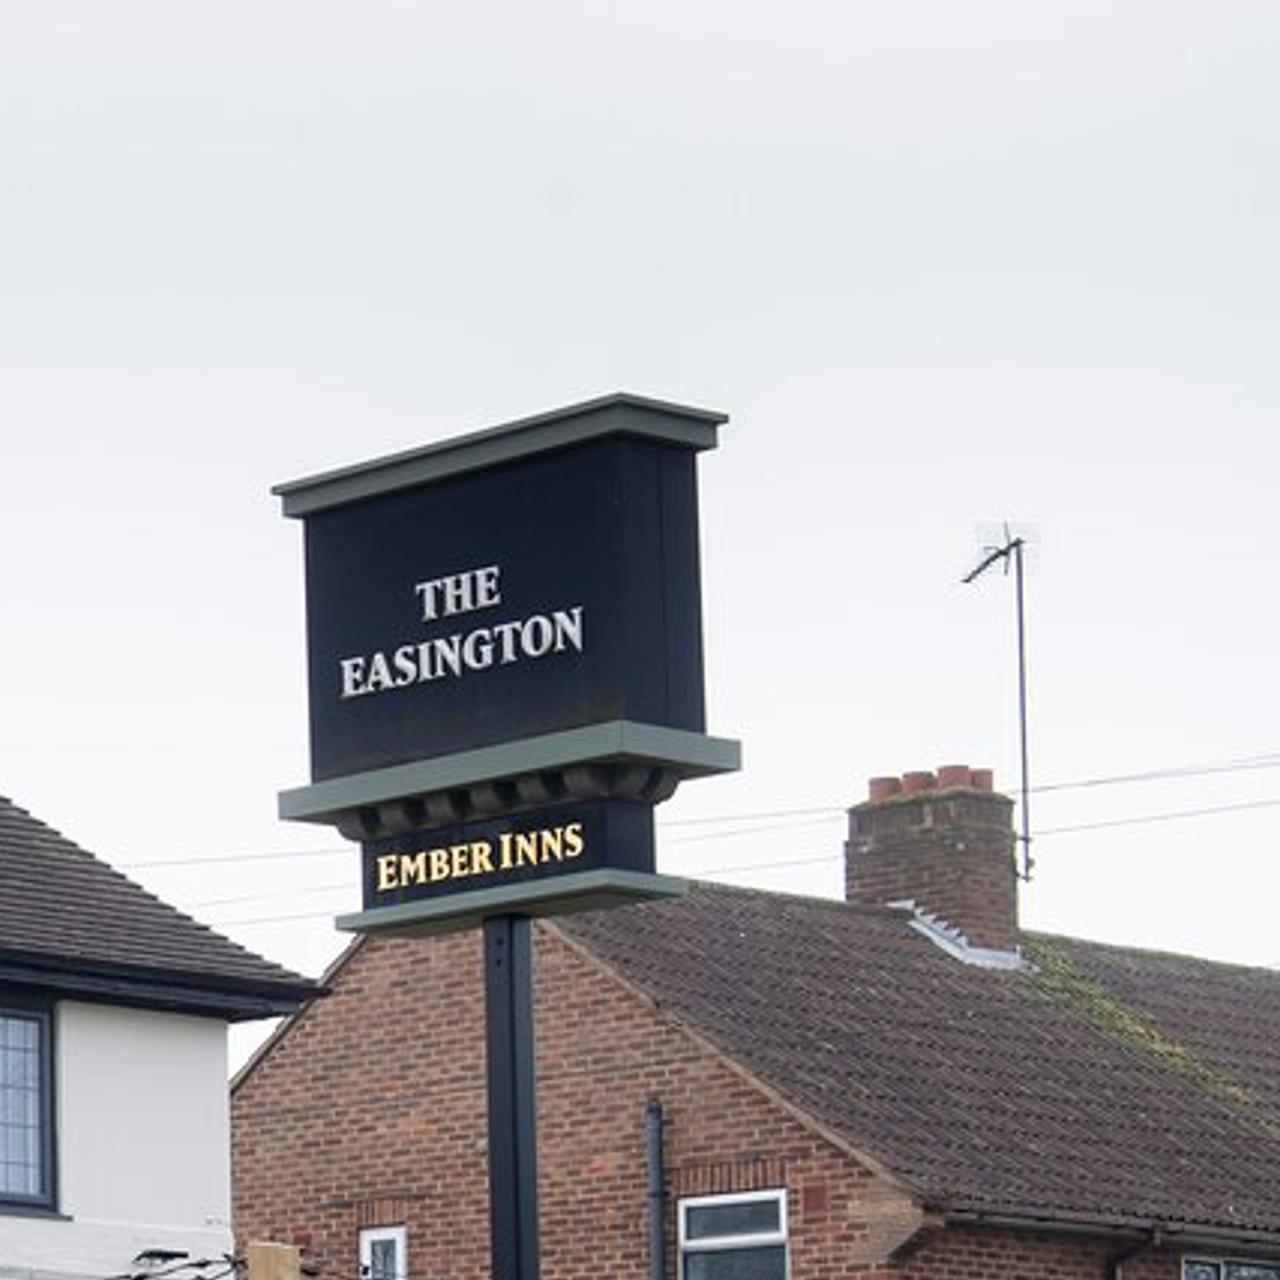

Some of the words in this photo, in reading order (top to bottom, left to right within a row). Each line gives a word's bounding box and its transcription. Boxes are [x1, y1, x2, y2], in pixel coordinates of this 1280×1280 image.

[415, 565, 501, 622] THE
[341, 606, 584, 698] EASINGTON
[376, 841, 494, 891] EMBER
[499, 823, 585, 867] INNS
